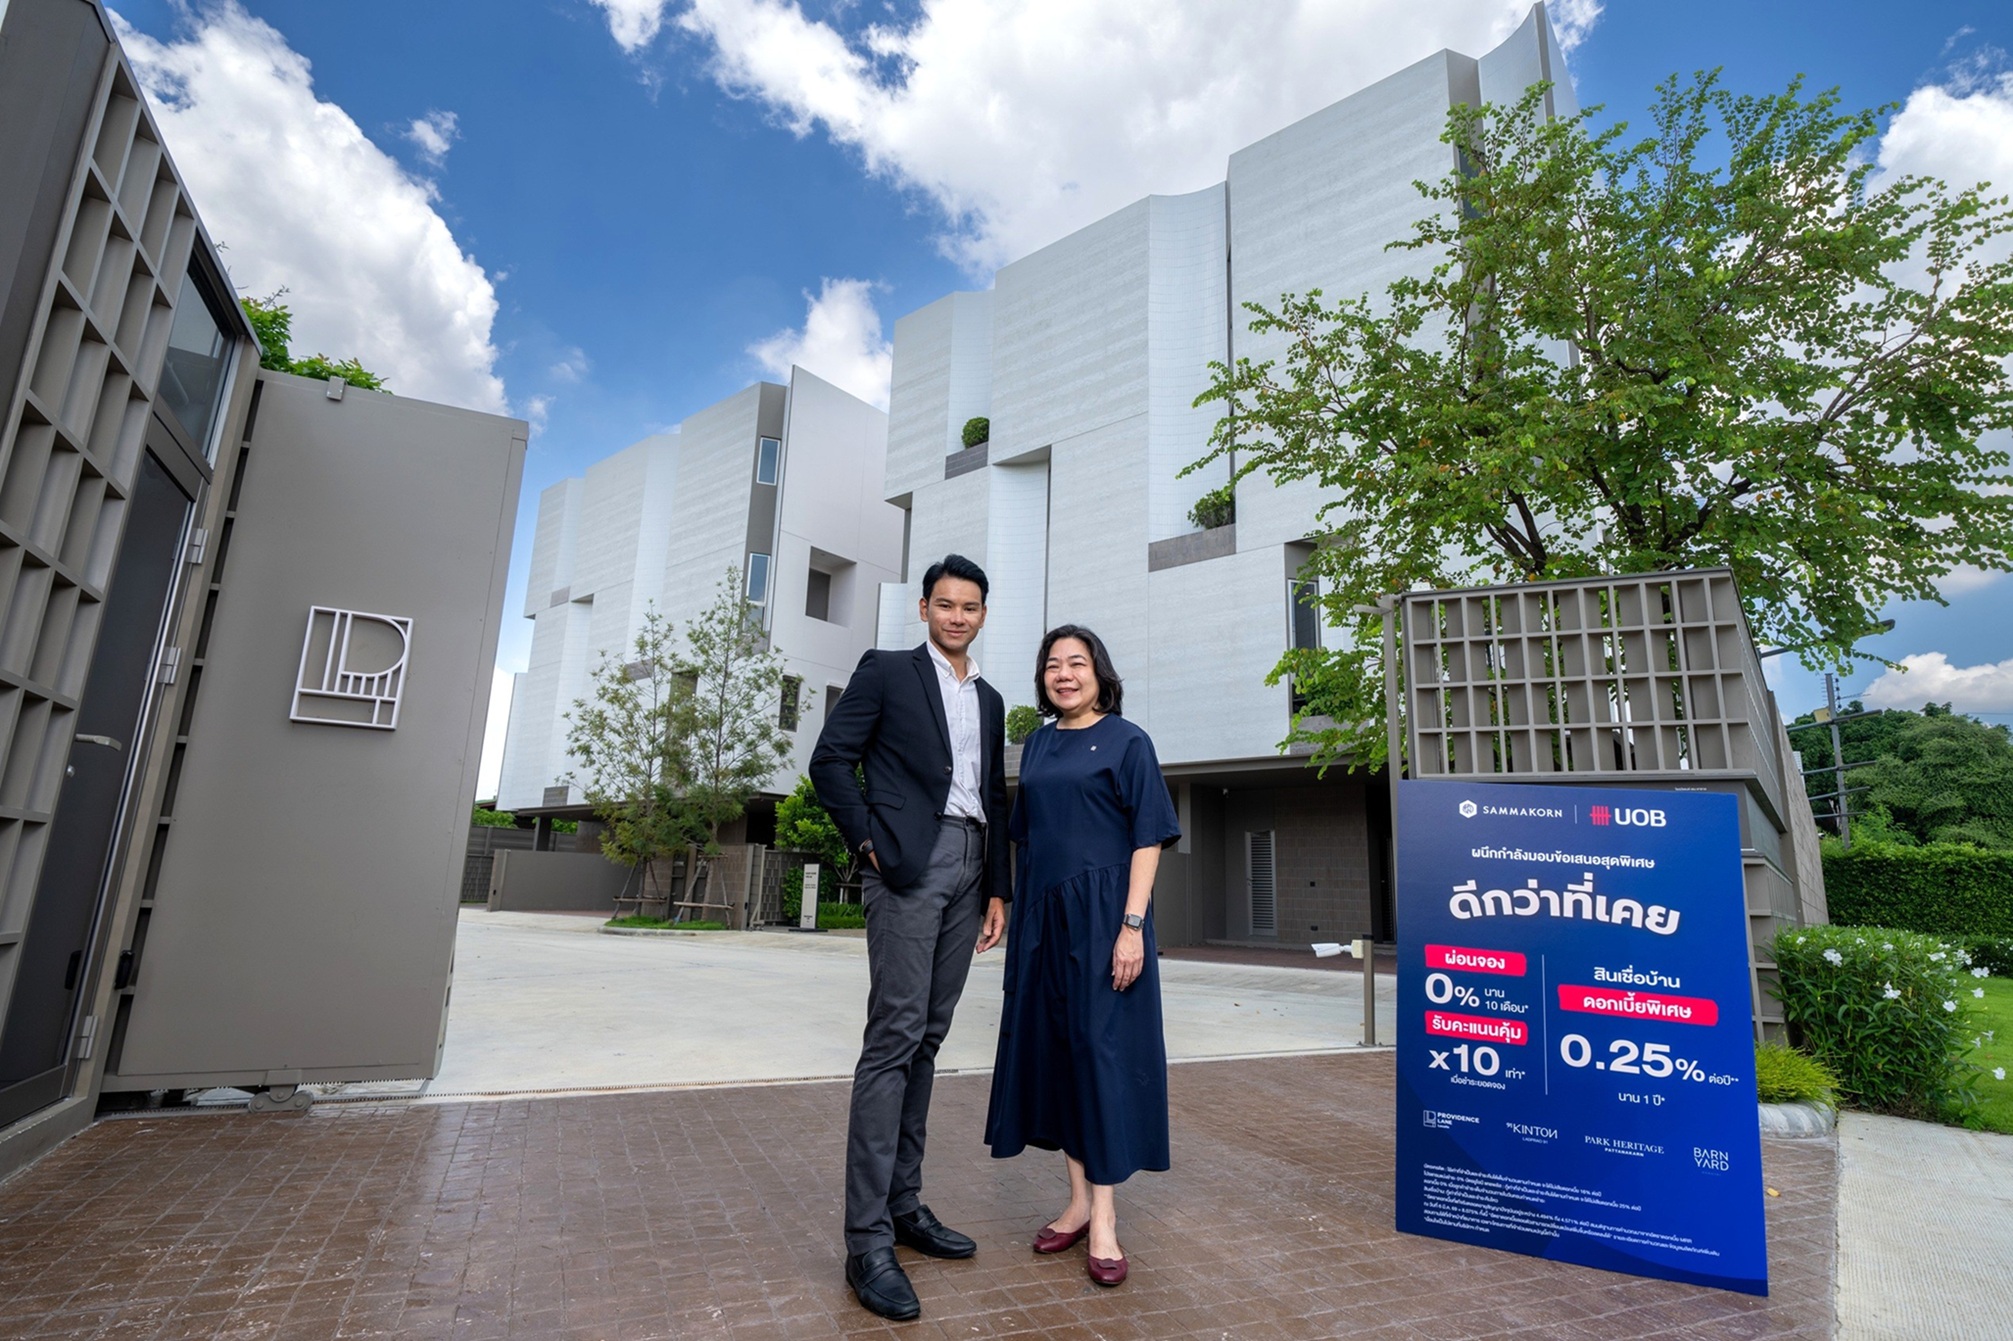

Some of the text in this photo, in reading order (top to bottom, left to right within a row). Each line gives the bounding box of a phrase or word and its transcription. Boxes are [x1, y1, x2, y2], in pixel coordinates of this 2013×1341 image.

[1483, 805, 1563, 818] SAMMAKORN
[1614, 807, 1667, 828] UOB
[1471, 845, 1656, 870] ผนึกกำลังมอบข้อเสนอสุดพิเศษ
[1449, 872, 1681, 935] ดีกว่าที่เคย
[1444, 949, 1506, 970] ผ่อนจอง
[1594, 965, 1681, 989] สินเชื่อบ้าน
[1425, 972, 1480, 1007] 0%
[1484, 988, 1505, 998] นาน
[1485, 1001, 1498, 1011] 10
[1583, 991, 1692, 1019] ดอกเบี้ยพิเศษ
[1432, 1014, 1522, 1043] รับคะแนนคุ้ม
[1428, 1043, 1500, 1076] x10
[1560, 1033, 1706, 1082] 0.25%
[1618, 1092, 1640, 1104] นาน
[1437, 1112, 1480, 1124] PROVIDENCE
[1584, 1135, 1665, 1155] PARK HERITAGE
[1693, 1147, 1729, 1162] BARN
[1694, 1157, 1730, 1172] YARD
